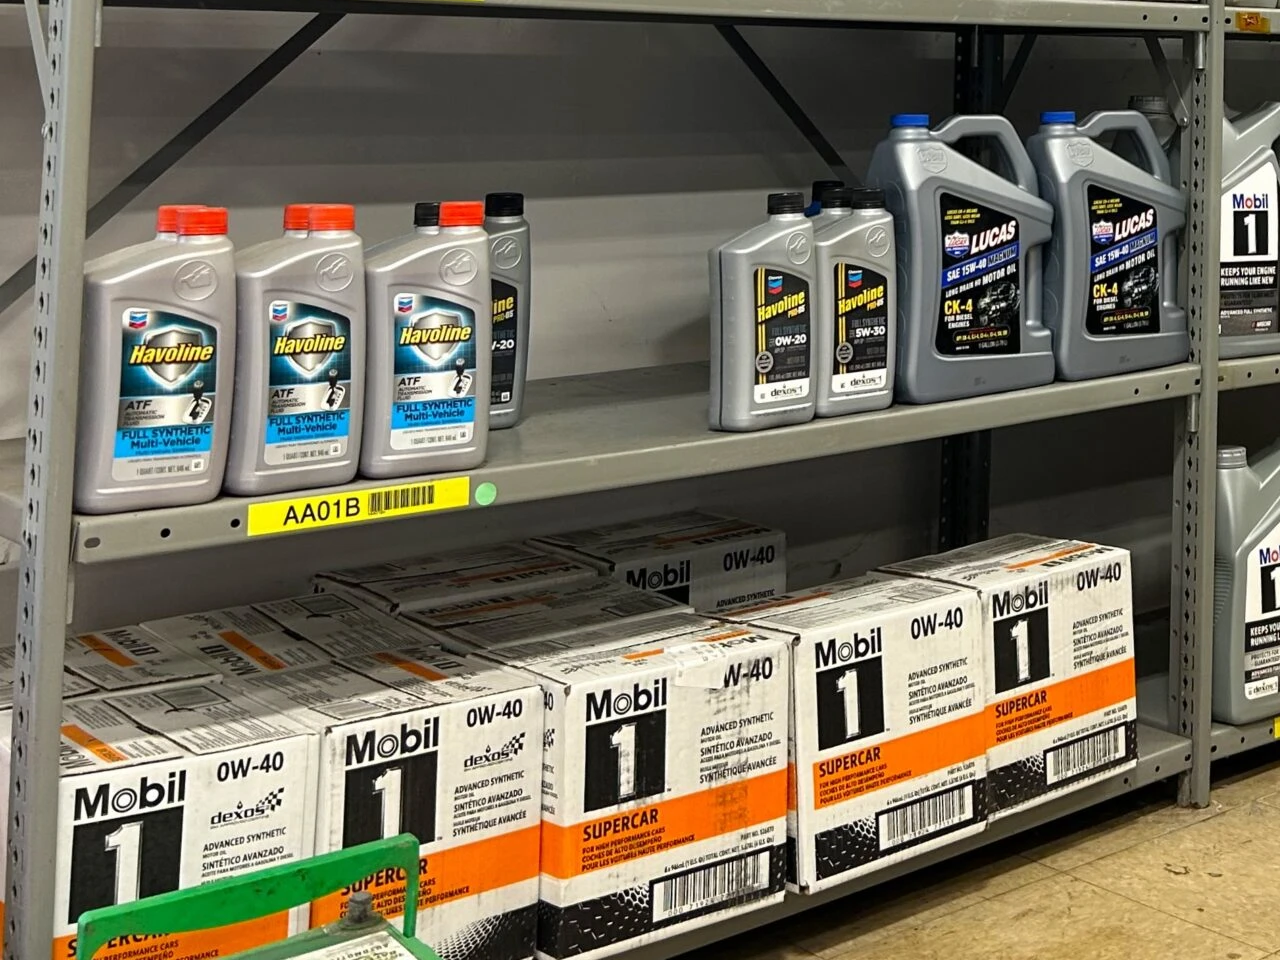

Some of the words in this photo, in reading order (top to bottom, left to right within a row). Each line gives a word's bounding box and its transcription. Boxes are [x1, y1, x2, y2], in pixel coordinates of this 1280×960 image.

[1232, 194, 1269, 210] Mobil
[970, 219, 1016, 255] LUCAS
[1114, 208, 1154, 242] LUCAS
[1221, 267, 1240, 277] KEEPS
[1241, 266, 1256, 275] YOUR
[1257, 265, 1276, 274] ENGINE
[1221, 277, 1248, 286] RUNNING
[1249, 276, 1260, 285] LIKE
[1261, 276, 1274, 284] NEW
[758, 291, 805, 320] Havoline
[944, 296, 973, 314] CK-4
[400, 324, 472, 345] Havoline
[775, 334, 807, 346] 0W-20
[855, 325, 886, 338] 5W-30
[128, 343, 214, 365] Havoline
[398, 376, 421, 387] ATF
[130, 436, 201, 449] Multi-Vehicle
[283, 497, 360, 525] AA01B
[723, 544, 776, 572] 0W-40
[992, 580, 1049, 619] Mobil
[911, 606, 963, 640] 0W-40
[815, 626, 882, 669] Mobil
[466, 698, 522, 728] 0W-40
[585, 677, 668, 722] Mobil
[995, 690, 1047, 719] SUPERCAR
[346, 716, 440, 767] Mobil
[216, 751, 284, 783] 0W-40
[610, 723, 637, 799] 1
[819, 746, 881, 778] SUPERCAR
[74, 769, 187, 821] Mobil
[454, 798, 486, 813] SINTÉTICO
[487, 788, 523, 804] AVANZADO
[583, 808, 659, 842] SUPERCAR
